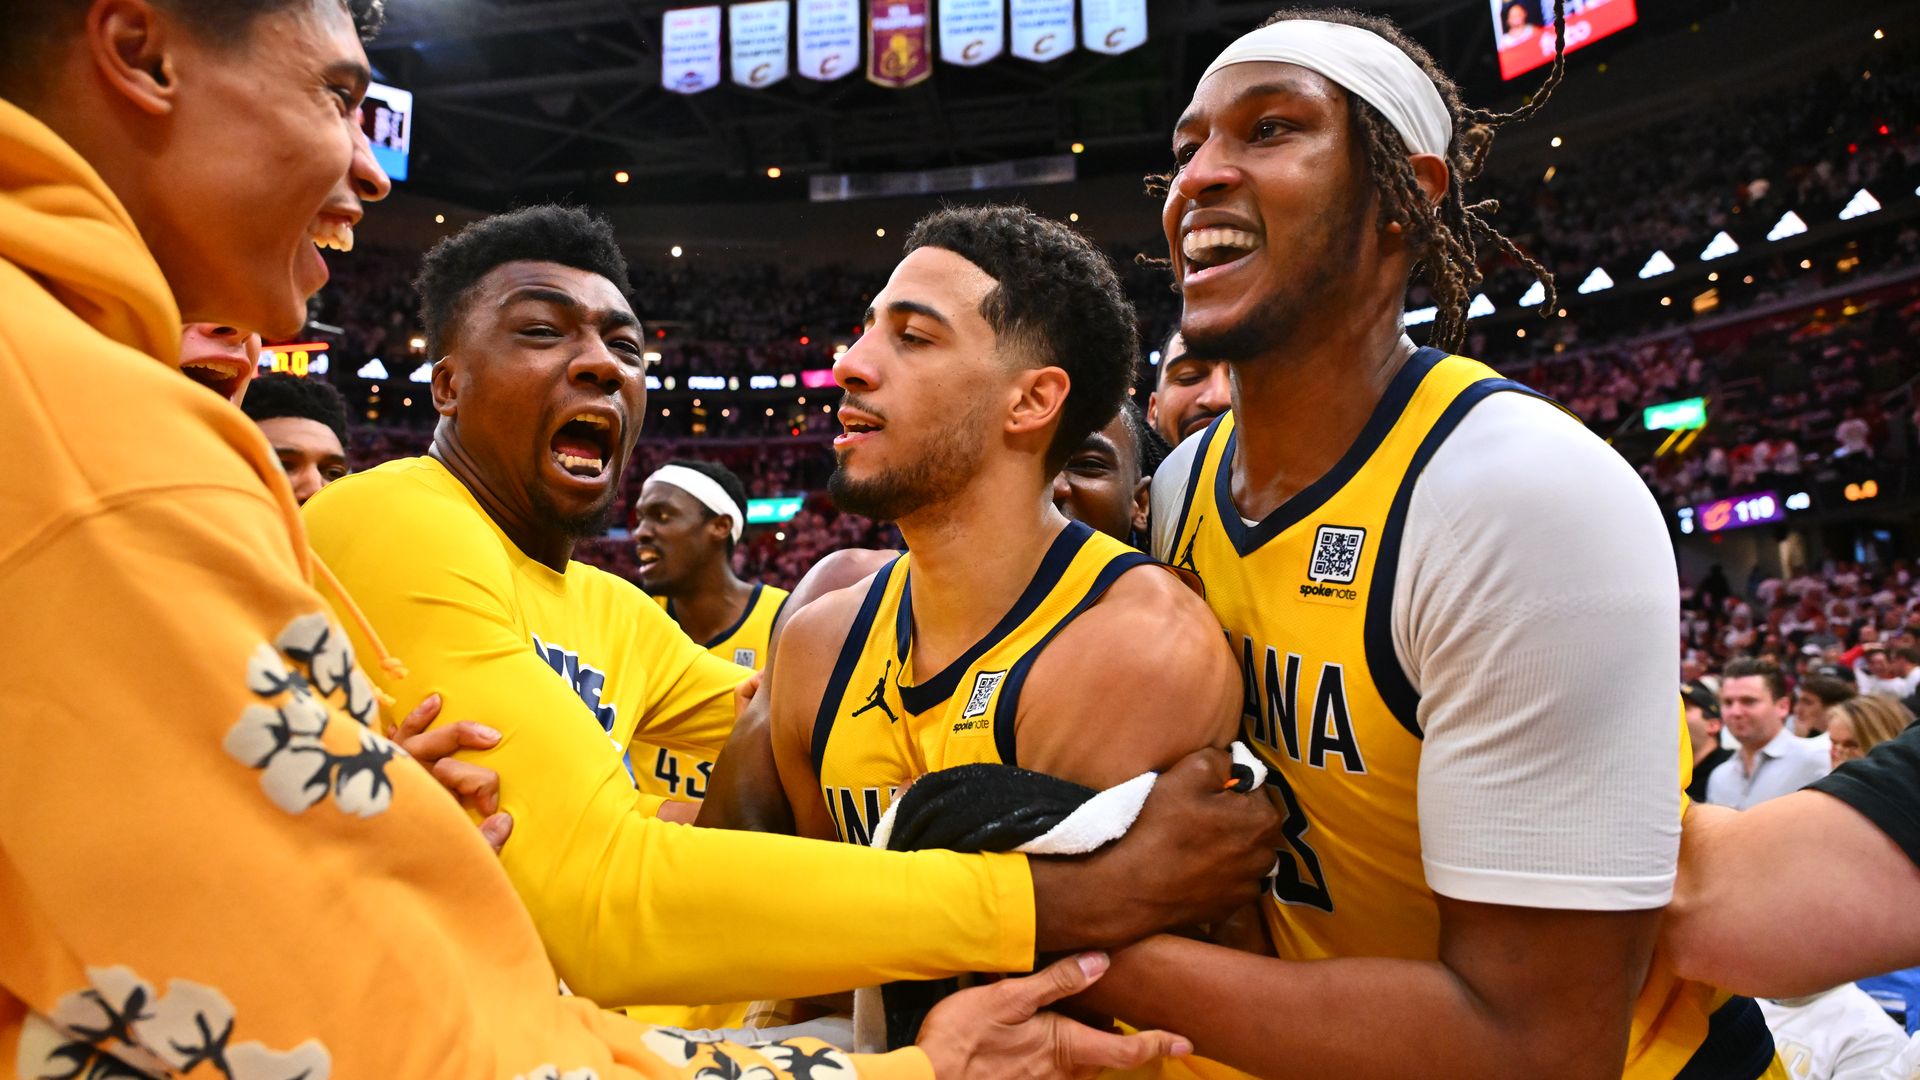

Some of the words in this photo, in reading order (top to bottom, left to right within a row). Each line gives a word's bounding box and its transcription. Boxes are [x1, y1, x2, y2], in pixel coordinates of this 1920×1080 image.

[1300, 584, 1357, 600] spokenote
[1223, 628, 1368, 775] ANA
[953, 719, 989, 734] spokenote
[825, 785, 899, 847] IN
